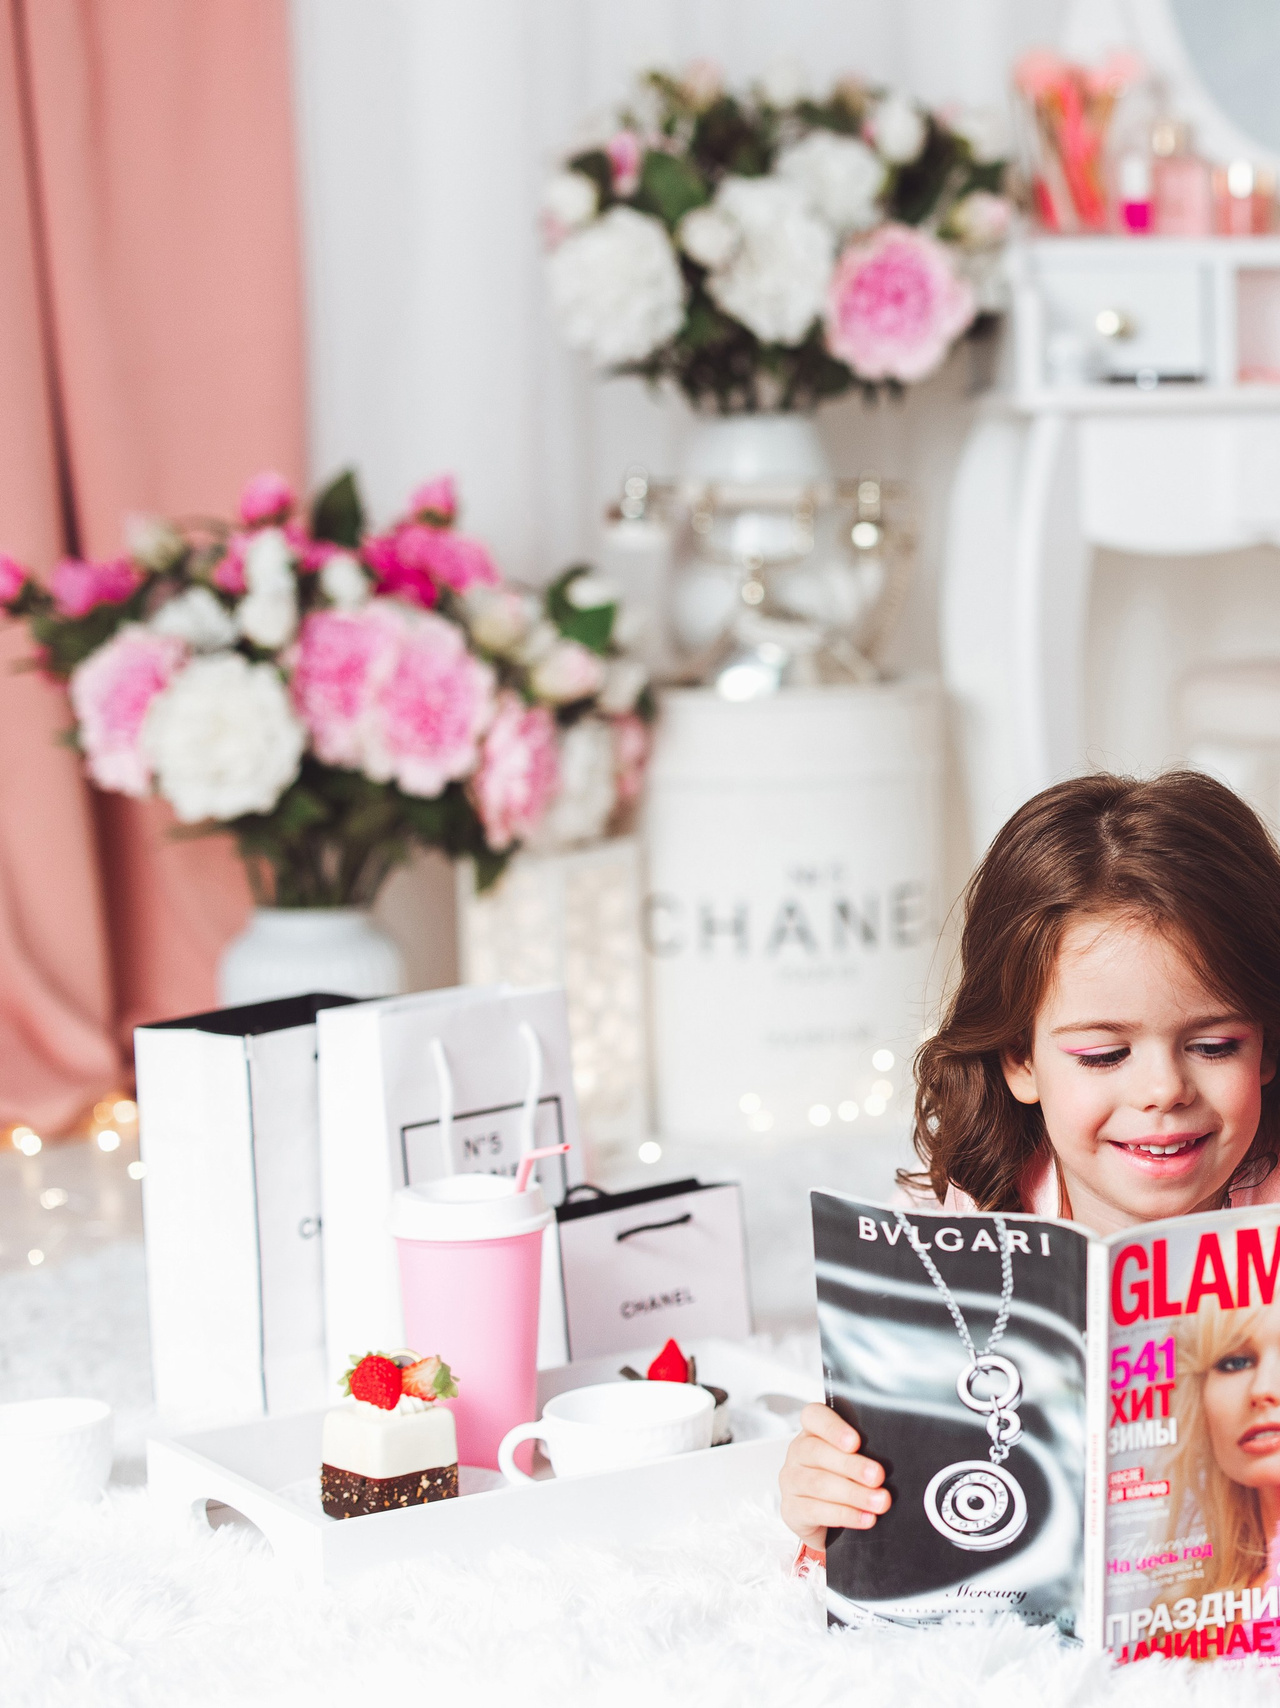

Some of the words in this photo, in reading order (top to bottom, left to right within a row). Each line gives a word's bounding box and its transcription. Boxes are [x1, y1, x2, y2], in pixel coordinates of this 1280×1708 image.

[640, 883, 940, 958] CHANE
[858, 1215, 1051, 1257] BVLGARI
[620, 1289, 695, 1319] CHANEL
[1111, 1336, 1176, 1390] 541
[1110, 1383, 1175, 1427] ХИТ
[1108, 1418, 1178, 1455] ЗИМЫ
[1106, 1558, 1130, 1575] На
[1183, 1543, 1214, 1560] год
[946, 1583, 1027, 1604] Mercury
